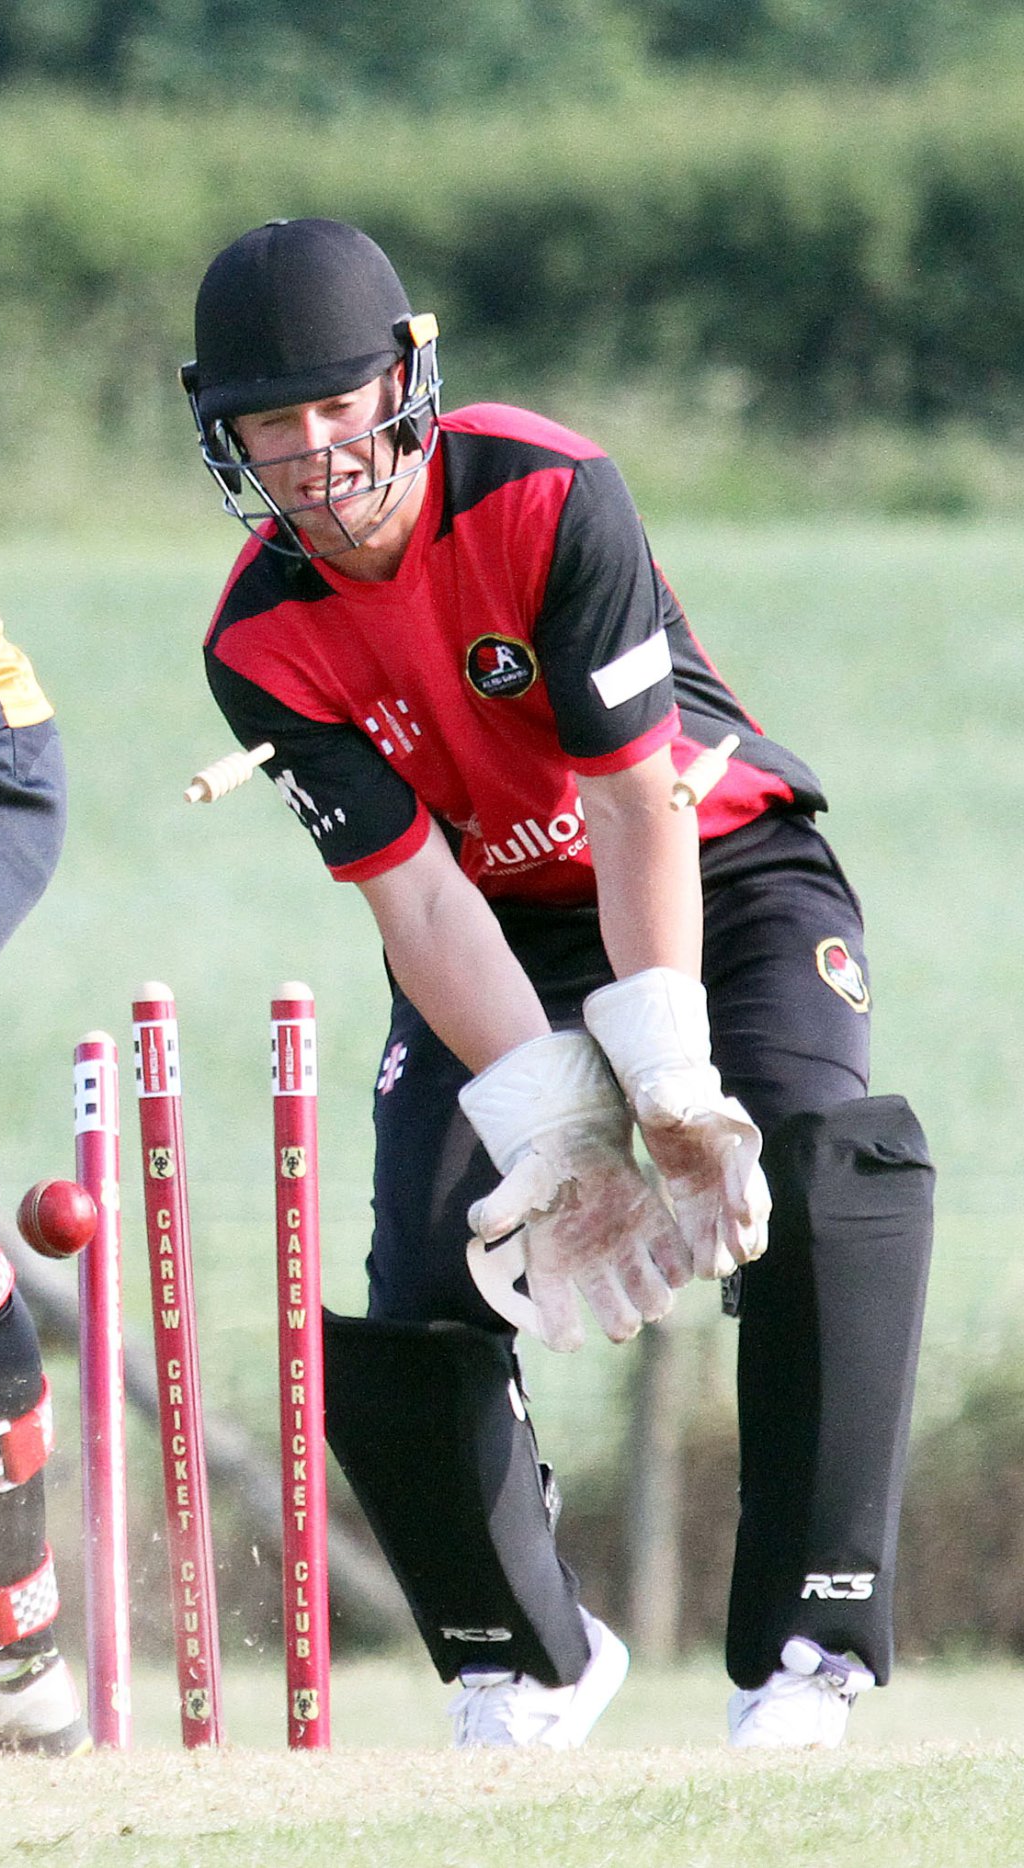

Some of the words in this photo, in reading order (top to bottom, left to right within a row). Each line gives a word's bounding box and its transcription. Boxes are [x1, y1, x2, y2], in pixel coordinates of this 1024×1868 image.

[156, 1208, 180, 1329] CAREW
[286, 1208, 307, 1329] CAREW
[167, 1359, 194, 1531] CRICKET
[290, 1359, 307, 1531] CRICKET
[181, 1560, 201, 1658] CLUB
[294, 1560, 311, 1659] CLUB
[801, 1573, 876, 1600] RCS
